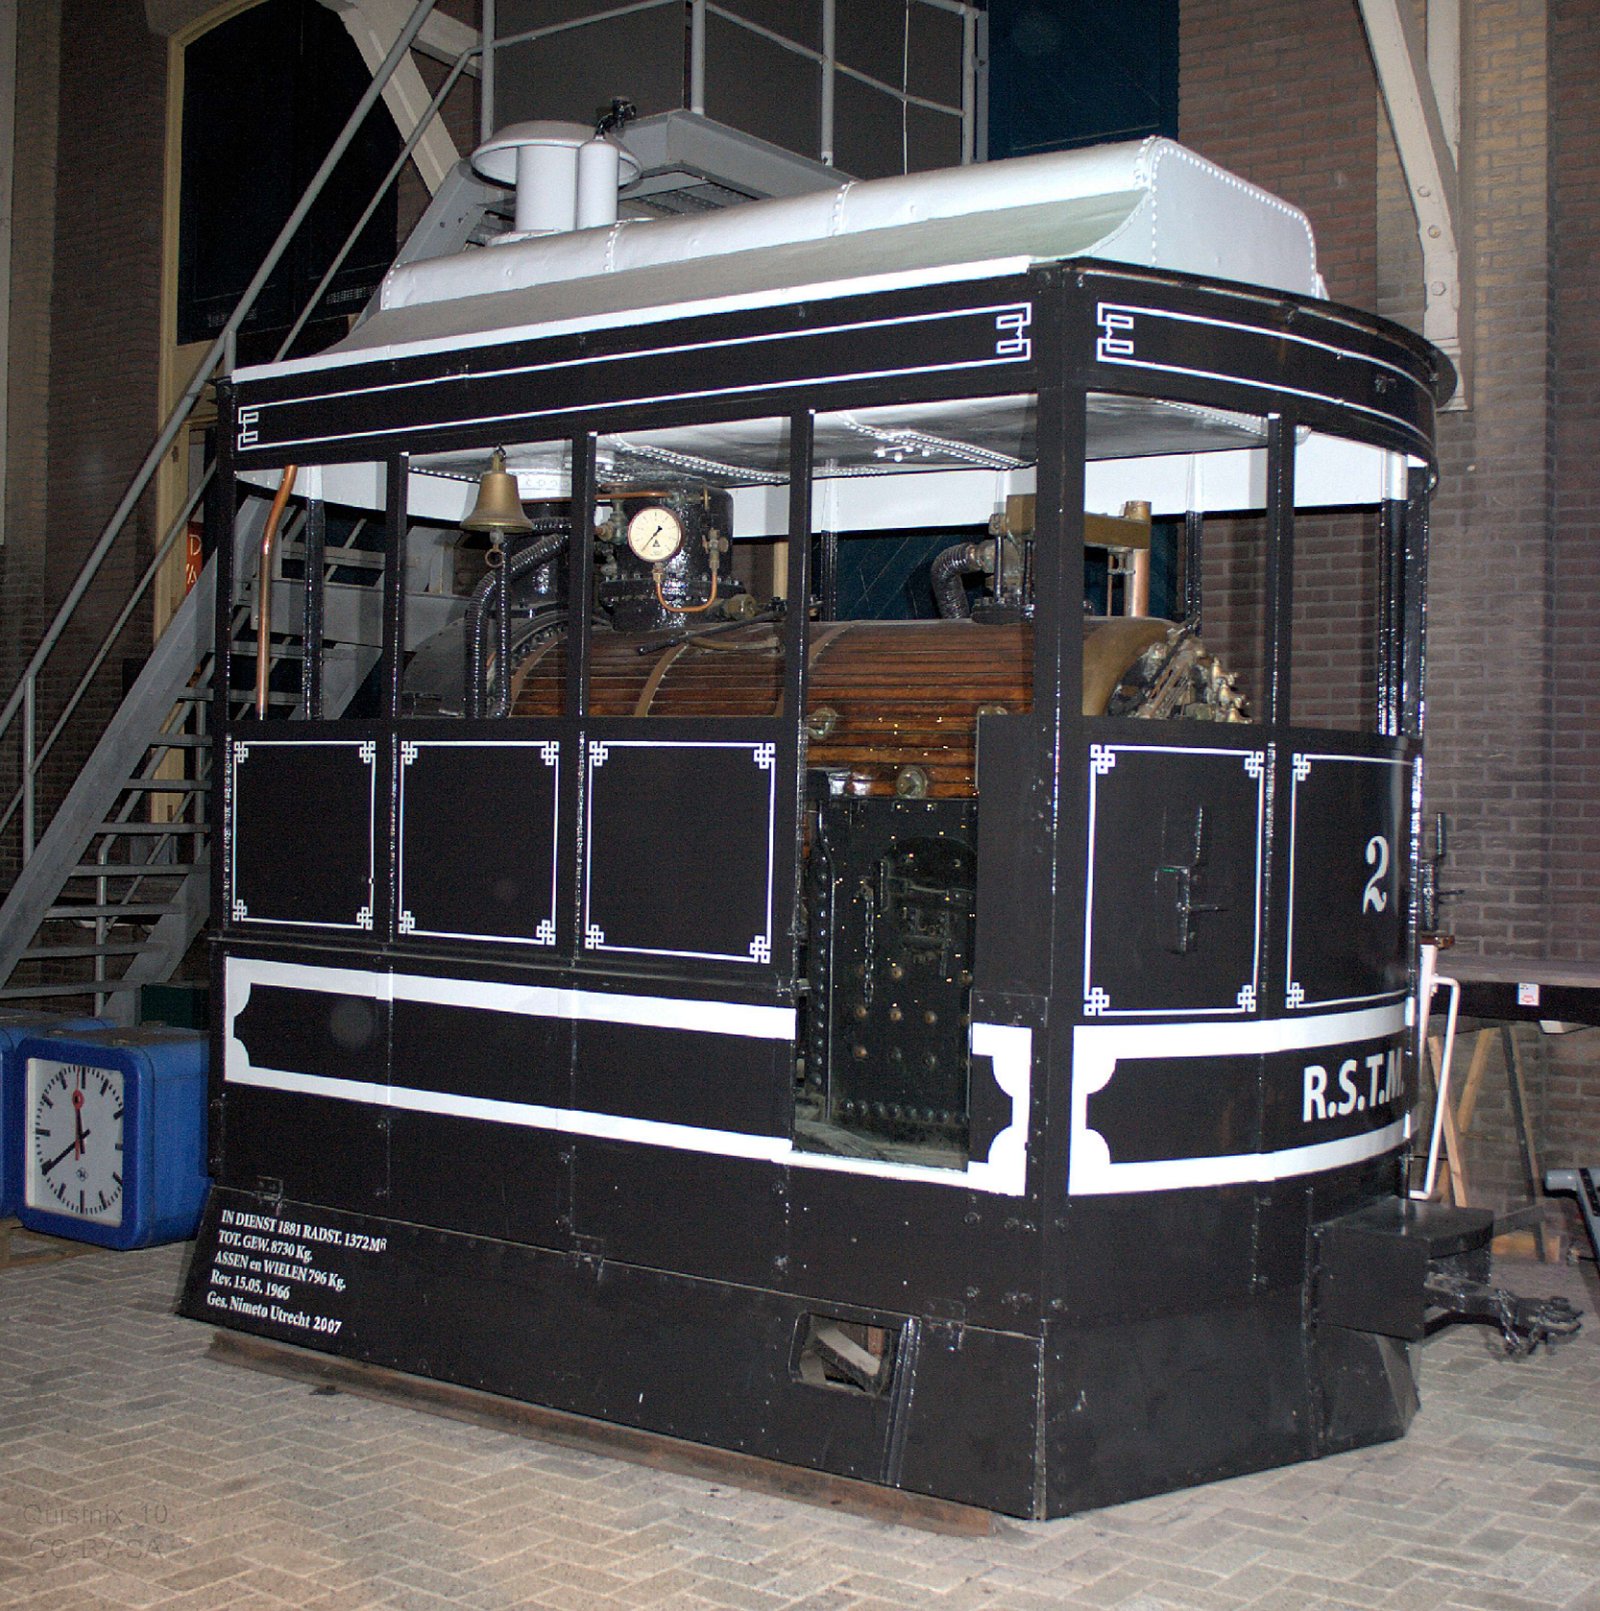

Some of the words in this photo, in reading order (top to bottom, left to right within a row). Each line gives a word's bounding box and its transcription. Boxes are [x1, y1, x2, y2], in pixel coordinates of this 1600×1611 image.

[1363, 836, 1389, 914] 2
[221, 1209, 235, 1224] IN
[236, 1212, 277, 1232] DIENST
[278, 1220, 301, 1237] 1881
[302, 1224, 342, 1244] RADST.
[219, 1229, 241, 1246] TOT.
[243, 1234, 269, 1252] GEW.
[271, 1240, 295, 1256] 8730
[295, 1245, 313, 1263] Kg.
[210, 1268, 232, 1286] Rev.
[265, 1282, 291, 1300] 1966
[214, 1250, 249, 1269] ASSEN
[250, 1260, 262, 1271] en
[263, 1259, 307, 1281] WIELEN
[308, 1269, 327, 1284] 796
[327, 1273, 346, 1292] Kg.
[207, 1290, 228, 1308] Ges.
[229, 1295, 268, 1317] Nimeto
[270, 1304, 310, 1328] Utrecht
[312, 1315, 343, 1334] 2007
